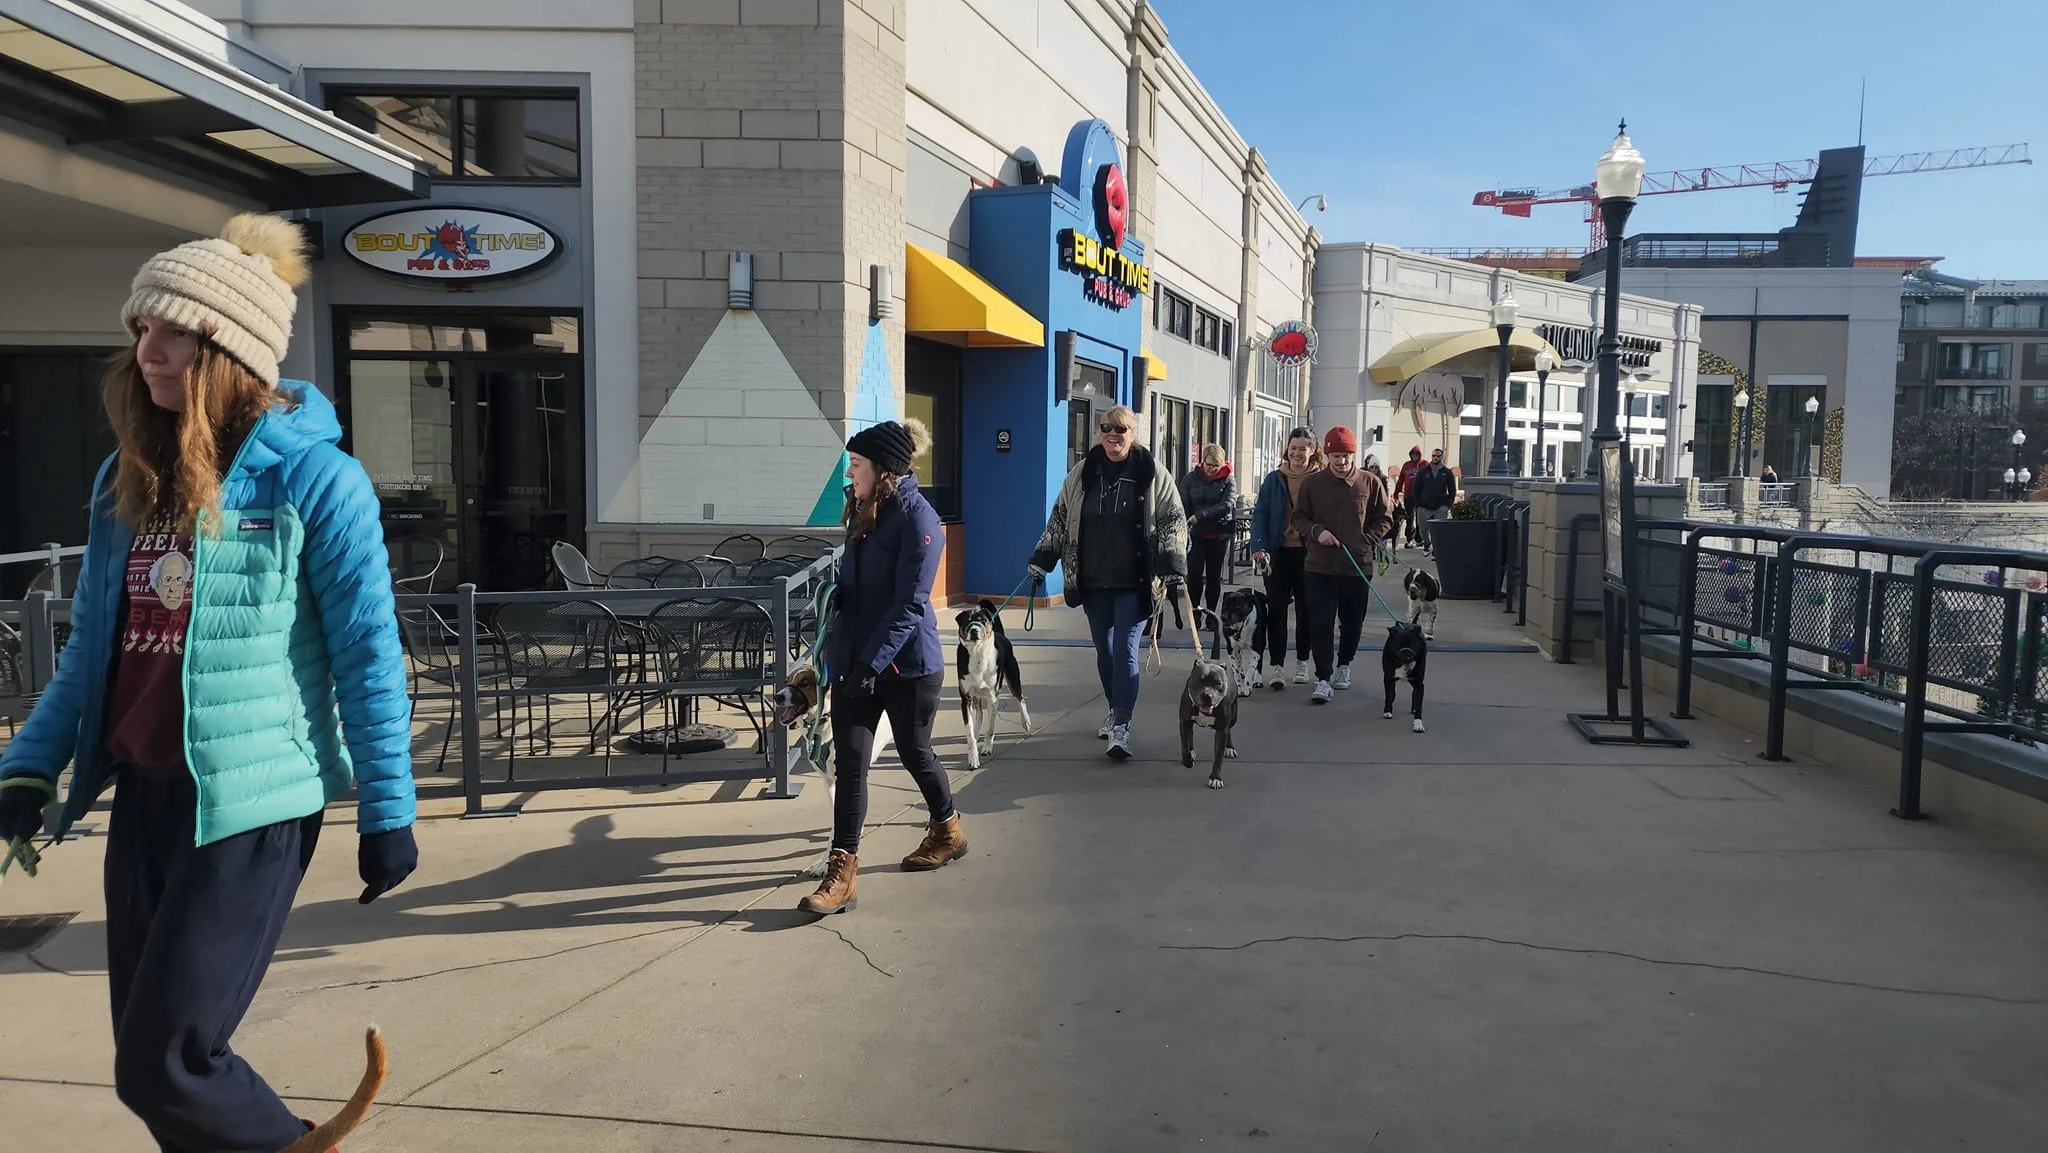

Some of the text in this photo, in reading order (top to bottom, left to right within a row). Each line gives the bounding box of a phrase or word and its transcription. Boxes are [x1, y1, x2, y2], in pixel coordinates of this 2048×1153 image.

[470, 231, 545, 251] TIME!
[407, 258, 435, 271] PUB
[438, 258, 450, 271] &
[131, 534, 178, 552] FEEL
